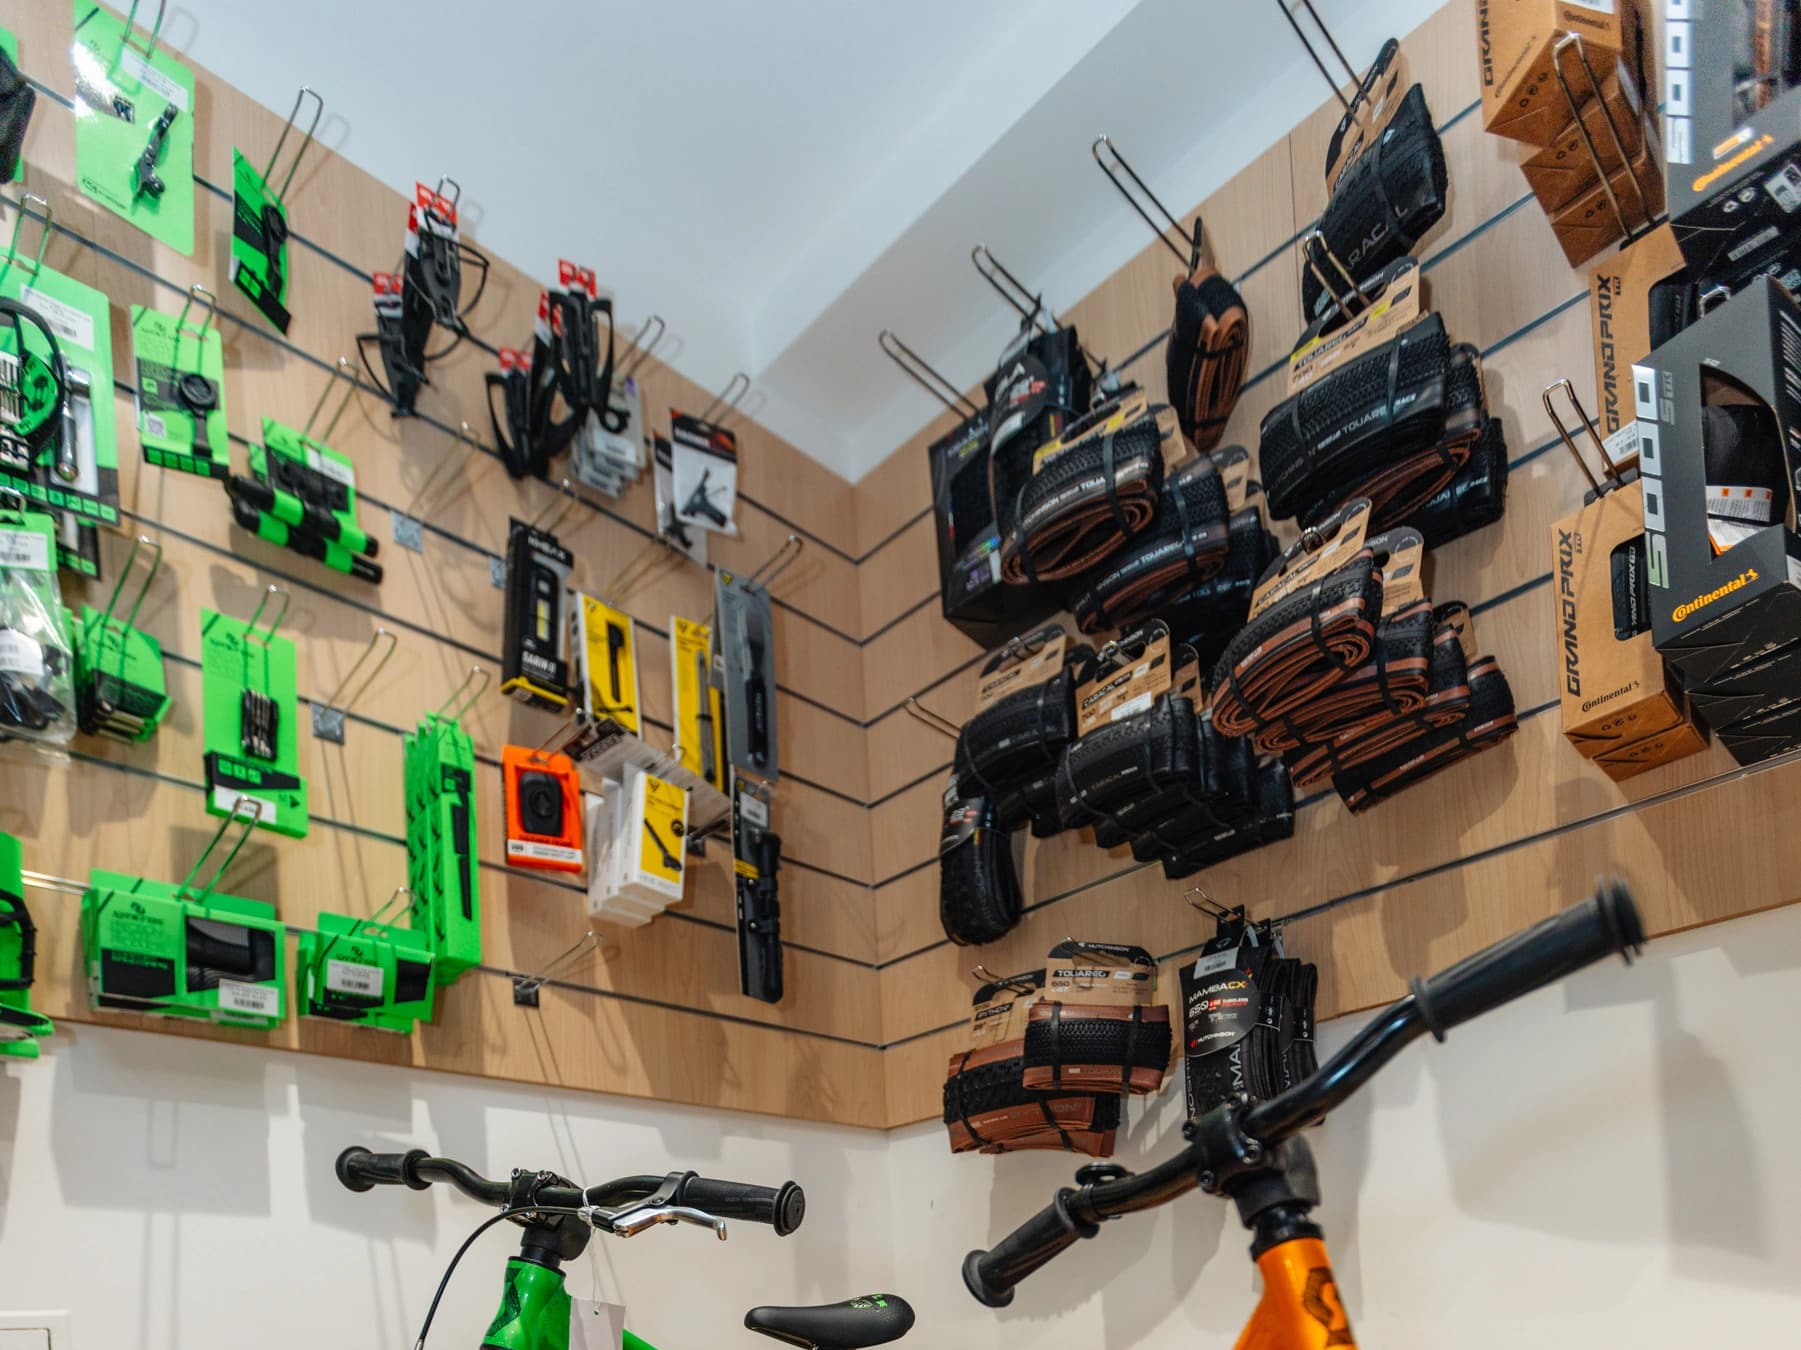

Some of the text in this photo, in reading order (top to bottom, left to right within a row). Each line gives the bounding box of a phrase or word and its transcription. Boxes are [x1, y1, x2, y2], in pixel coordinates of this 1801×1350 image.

[1597, 273, 1613, 341] PRIX
[1600, 344, 1620, 435] GRAND
[1558, 527, 1575, 599] PRIX
[1671, 574, 1747, 623] Continental
[1560, 601, 1581, 698] GRAND
[1581, 683, 1633, 713] Continental
